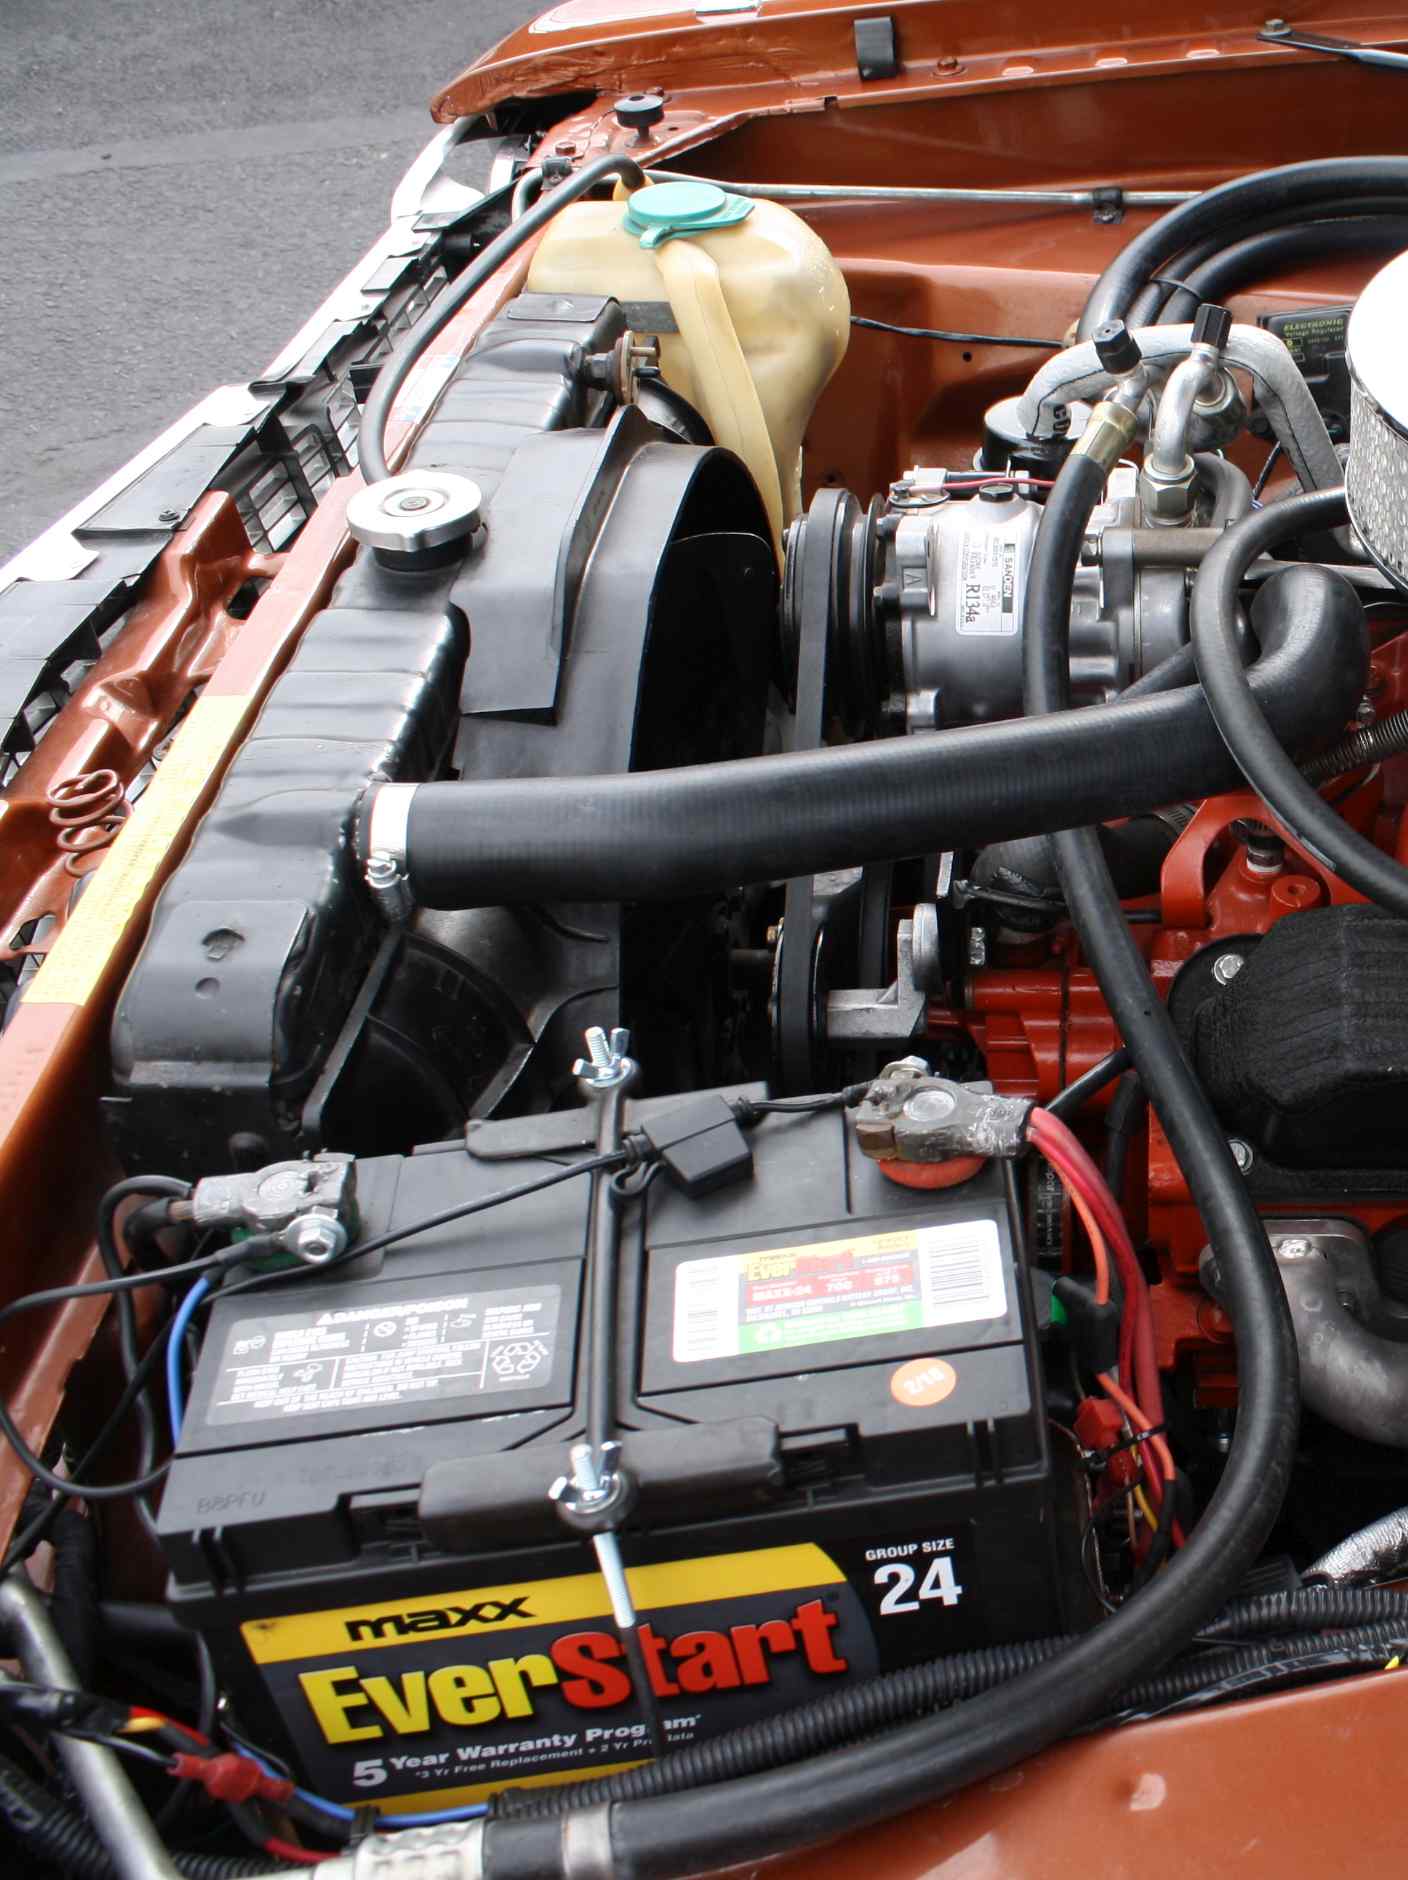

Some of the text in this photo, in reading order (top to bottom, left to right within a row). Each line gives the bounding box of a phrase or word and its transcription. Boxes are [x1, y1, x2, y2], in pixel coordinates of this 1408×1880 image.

[965, 583, 981, 624] R134a
[865, 1538, 956, 1561] GROUP SIZE
[874, 1556, 963, 1616] 24
[345, 1595, 537, 1642] maxx
[298, 1599, 849, 1745] EverStart
[352, 1758, 387, 1787] 5
[389, 1752, 450, 1770] Year
[456, 1733, 577, 1760] Warranty
[434, 1768, 450, 1777] Yr
[454, 1763, 486, 1773] Free
[490, 1748, 583, 1768] Replacement
[614, 1741, 628, 1750] Yr
